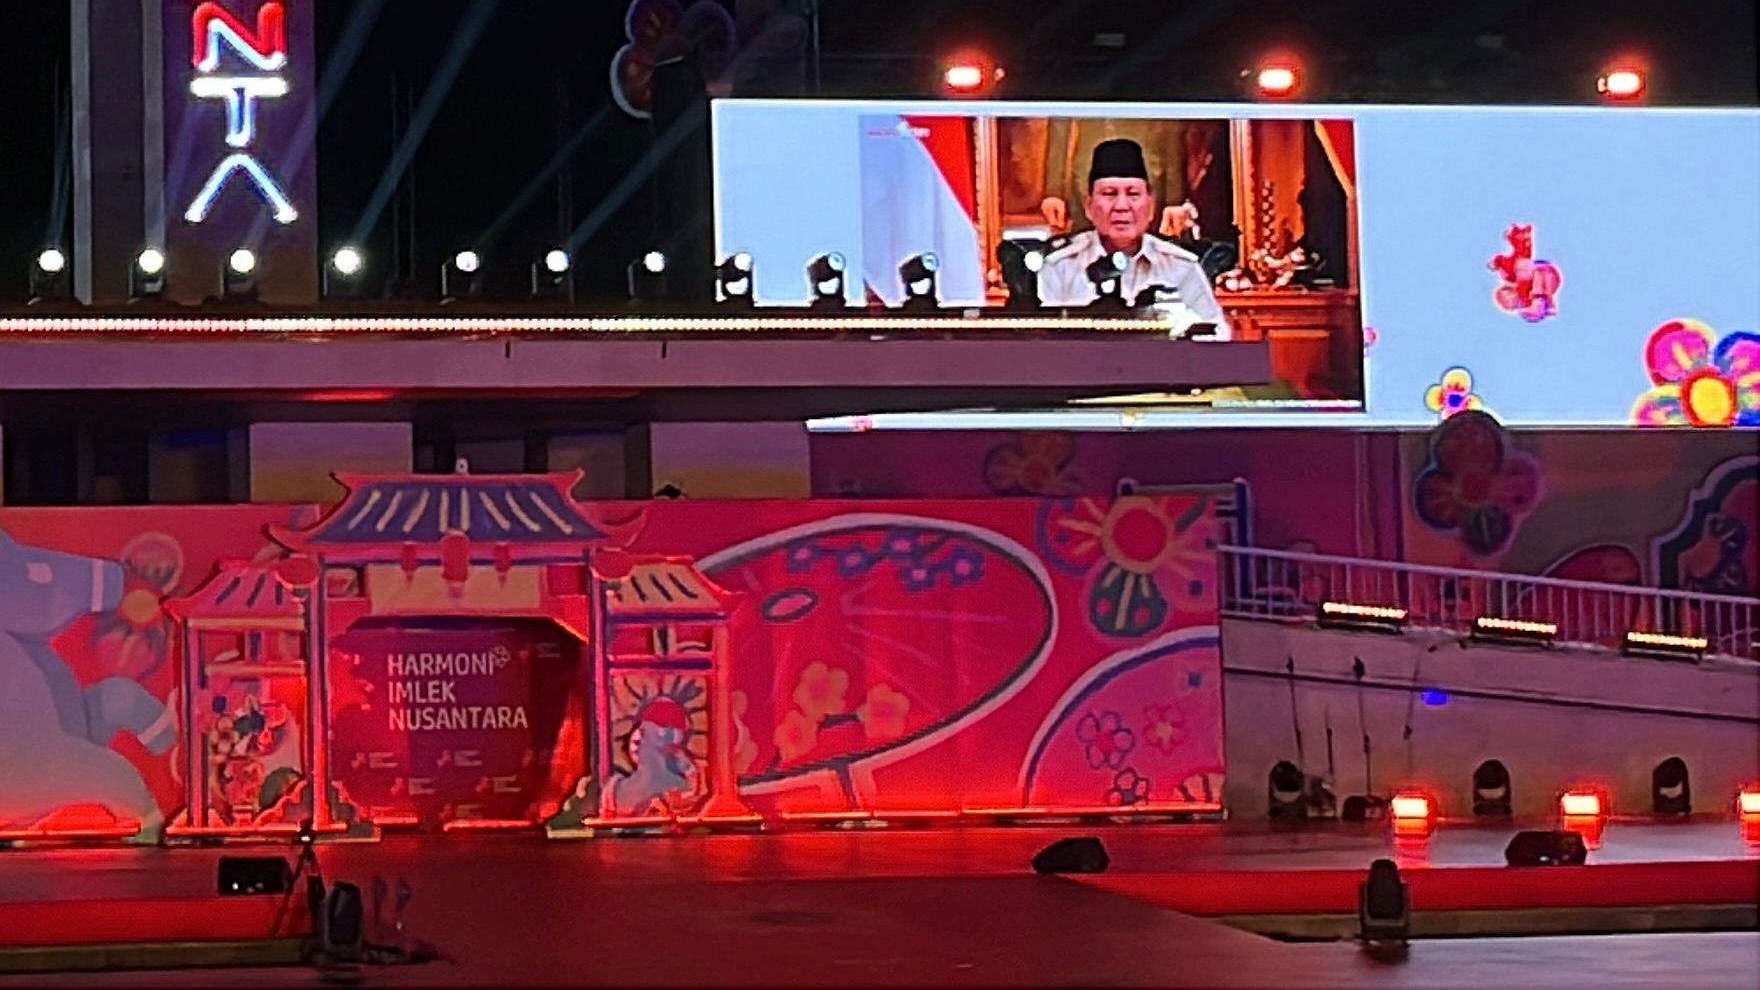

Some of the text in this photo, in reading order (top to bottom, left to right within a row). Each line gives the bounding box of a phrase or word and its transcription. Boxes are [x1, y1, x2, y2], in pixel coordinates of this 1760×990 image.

[387, 652, 494, 677] HARMONI
[388, 680, 456, 704] IMLEK
[388, 706, 529, 731] NUSANTARA
